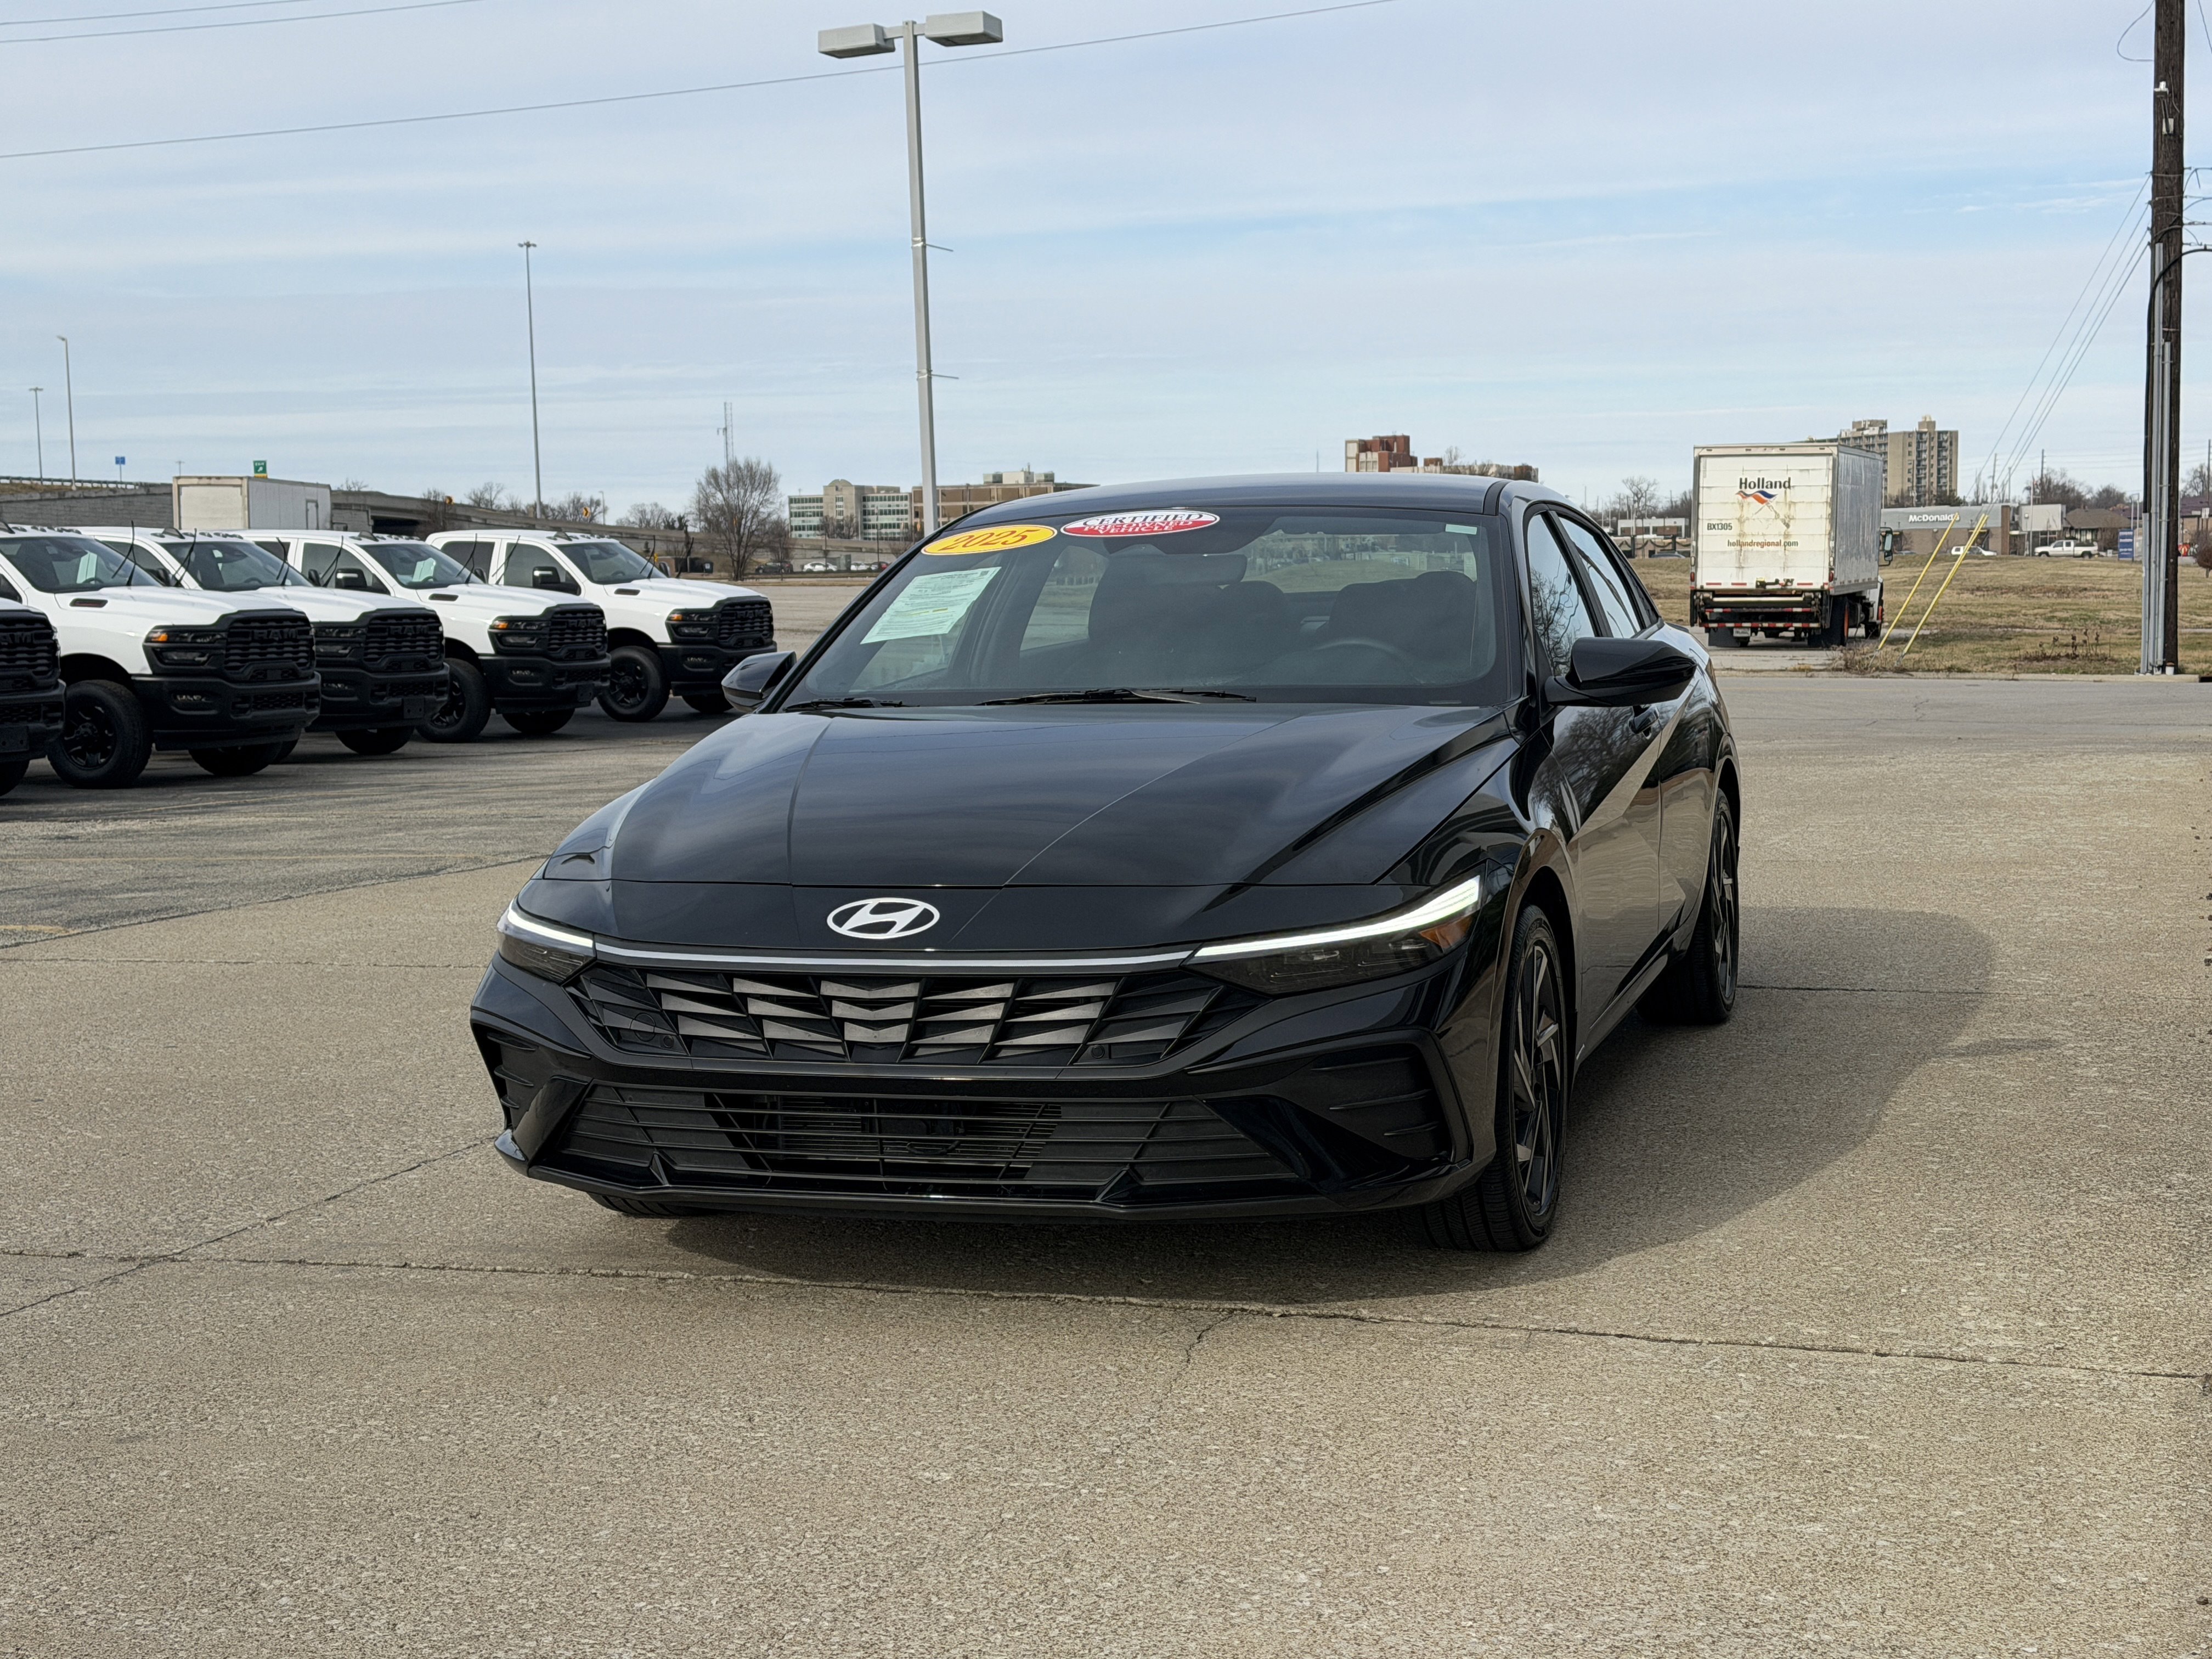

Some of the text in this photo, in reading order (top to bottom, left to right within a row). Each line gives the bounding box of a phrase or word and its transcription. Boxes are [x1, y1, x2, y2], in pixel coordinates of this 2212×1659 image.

[1739, 477, 1791, 489] Holland
[1083, 514, 1203, 526] CERTIFIED
[1084, 521, 1193, 531] PRE-OWNED
[1098, 525, 1174, 534] VEHICLE
[938, 529, 1040, 551] 2025
[1728, 539, 1799, 548] hollandregional.com
[568, 619, 597, 628] RAM
[253, 629, 297, 640] RAM
[390, 625, 430, 635] RAM
[0, 633, 35, 644] AM
